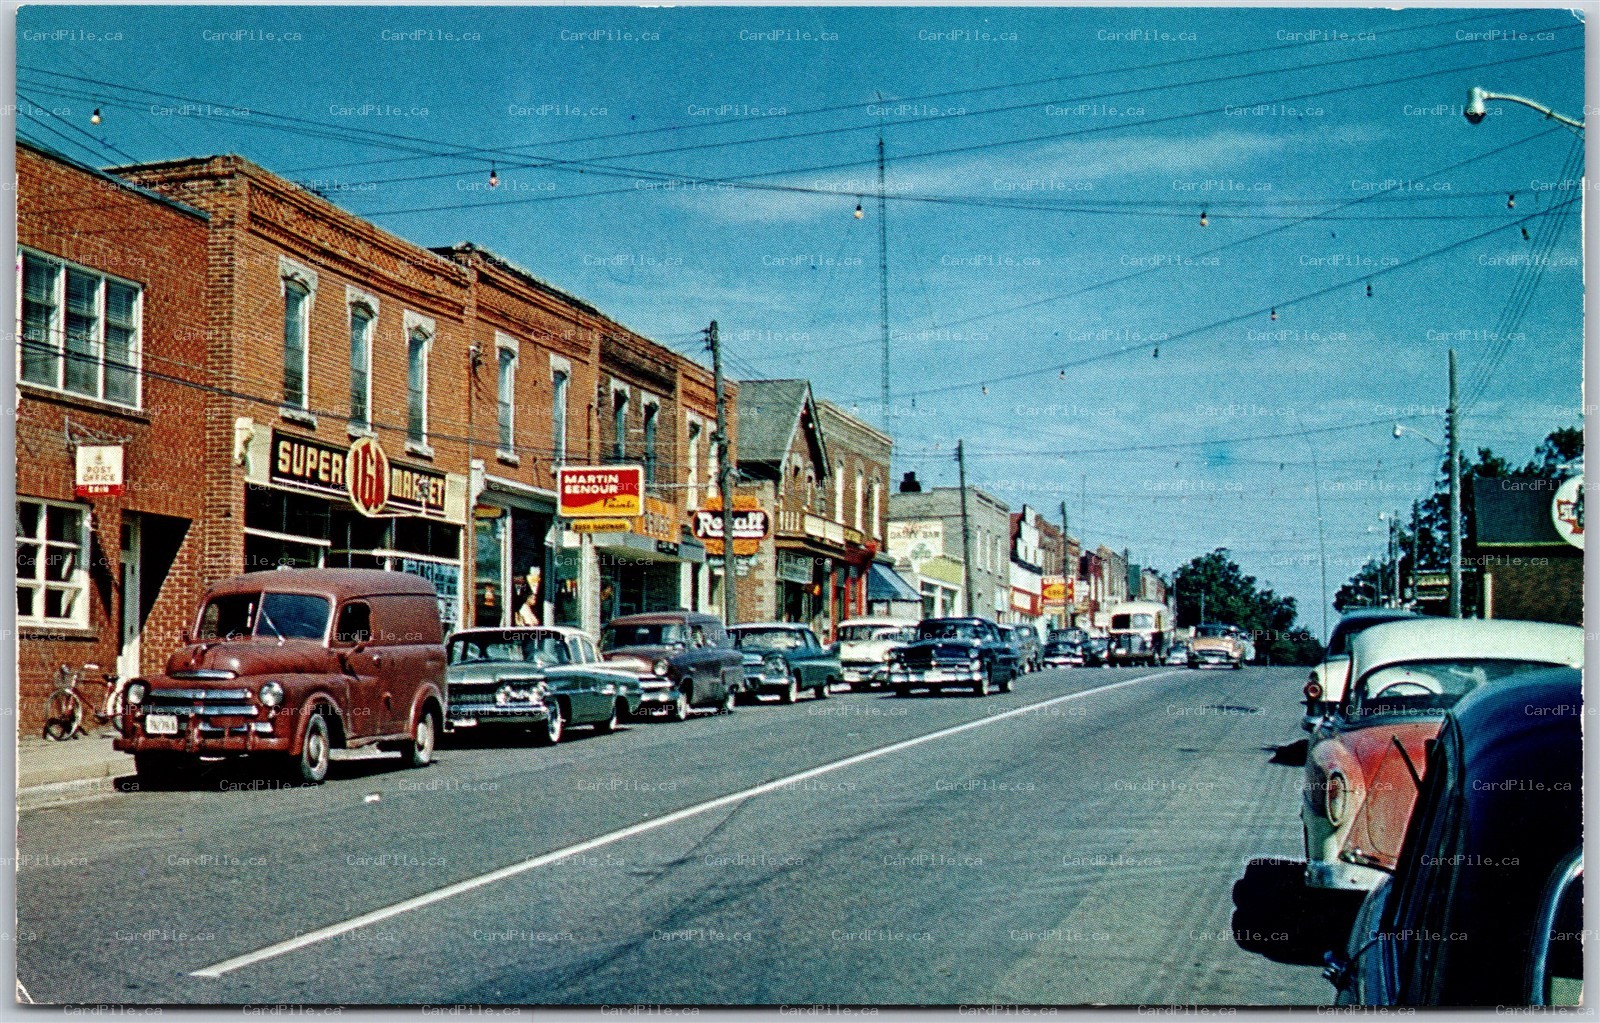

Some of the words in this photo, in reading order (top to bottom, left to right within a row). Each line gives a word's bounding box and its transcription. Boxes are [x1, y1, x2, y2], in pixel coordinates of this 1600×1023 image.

[86, 466, 112, 474] POST
[278, 440, 343, 483] SUPER
[391, 467, 445, 506] MARET
[82, 473, 116, 482] OFFICE
[564, 474, 619, 484] MARTIN
[697, 512, 765, 537] Reall
